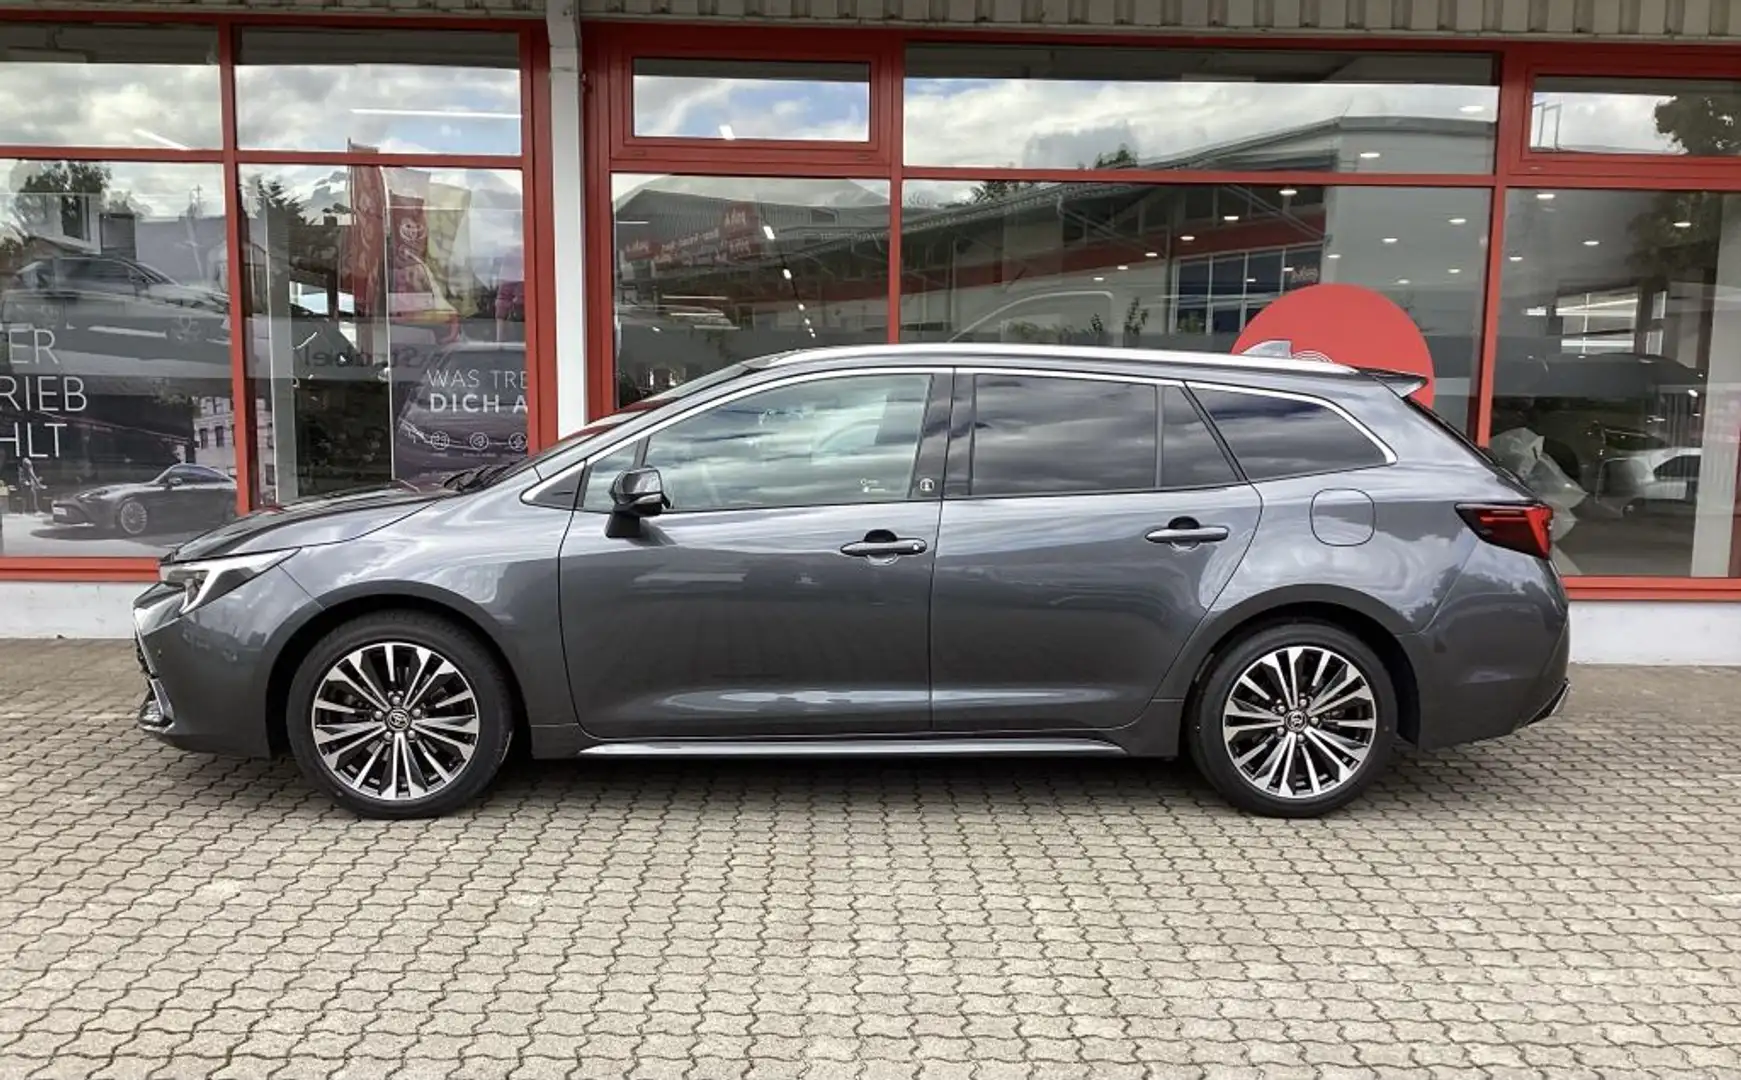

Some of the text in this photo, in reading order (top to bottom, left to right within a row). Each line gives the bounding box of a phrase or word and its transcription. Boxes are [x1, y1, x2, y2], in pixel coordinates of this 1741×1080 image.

[9, 328, 59, 364] ER
[0, 375, 87, 411] RIEB
[426, 369, 528, 389] WAS TRE
[430, 393, 528, 414] DICH A
